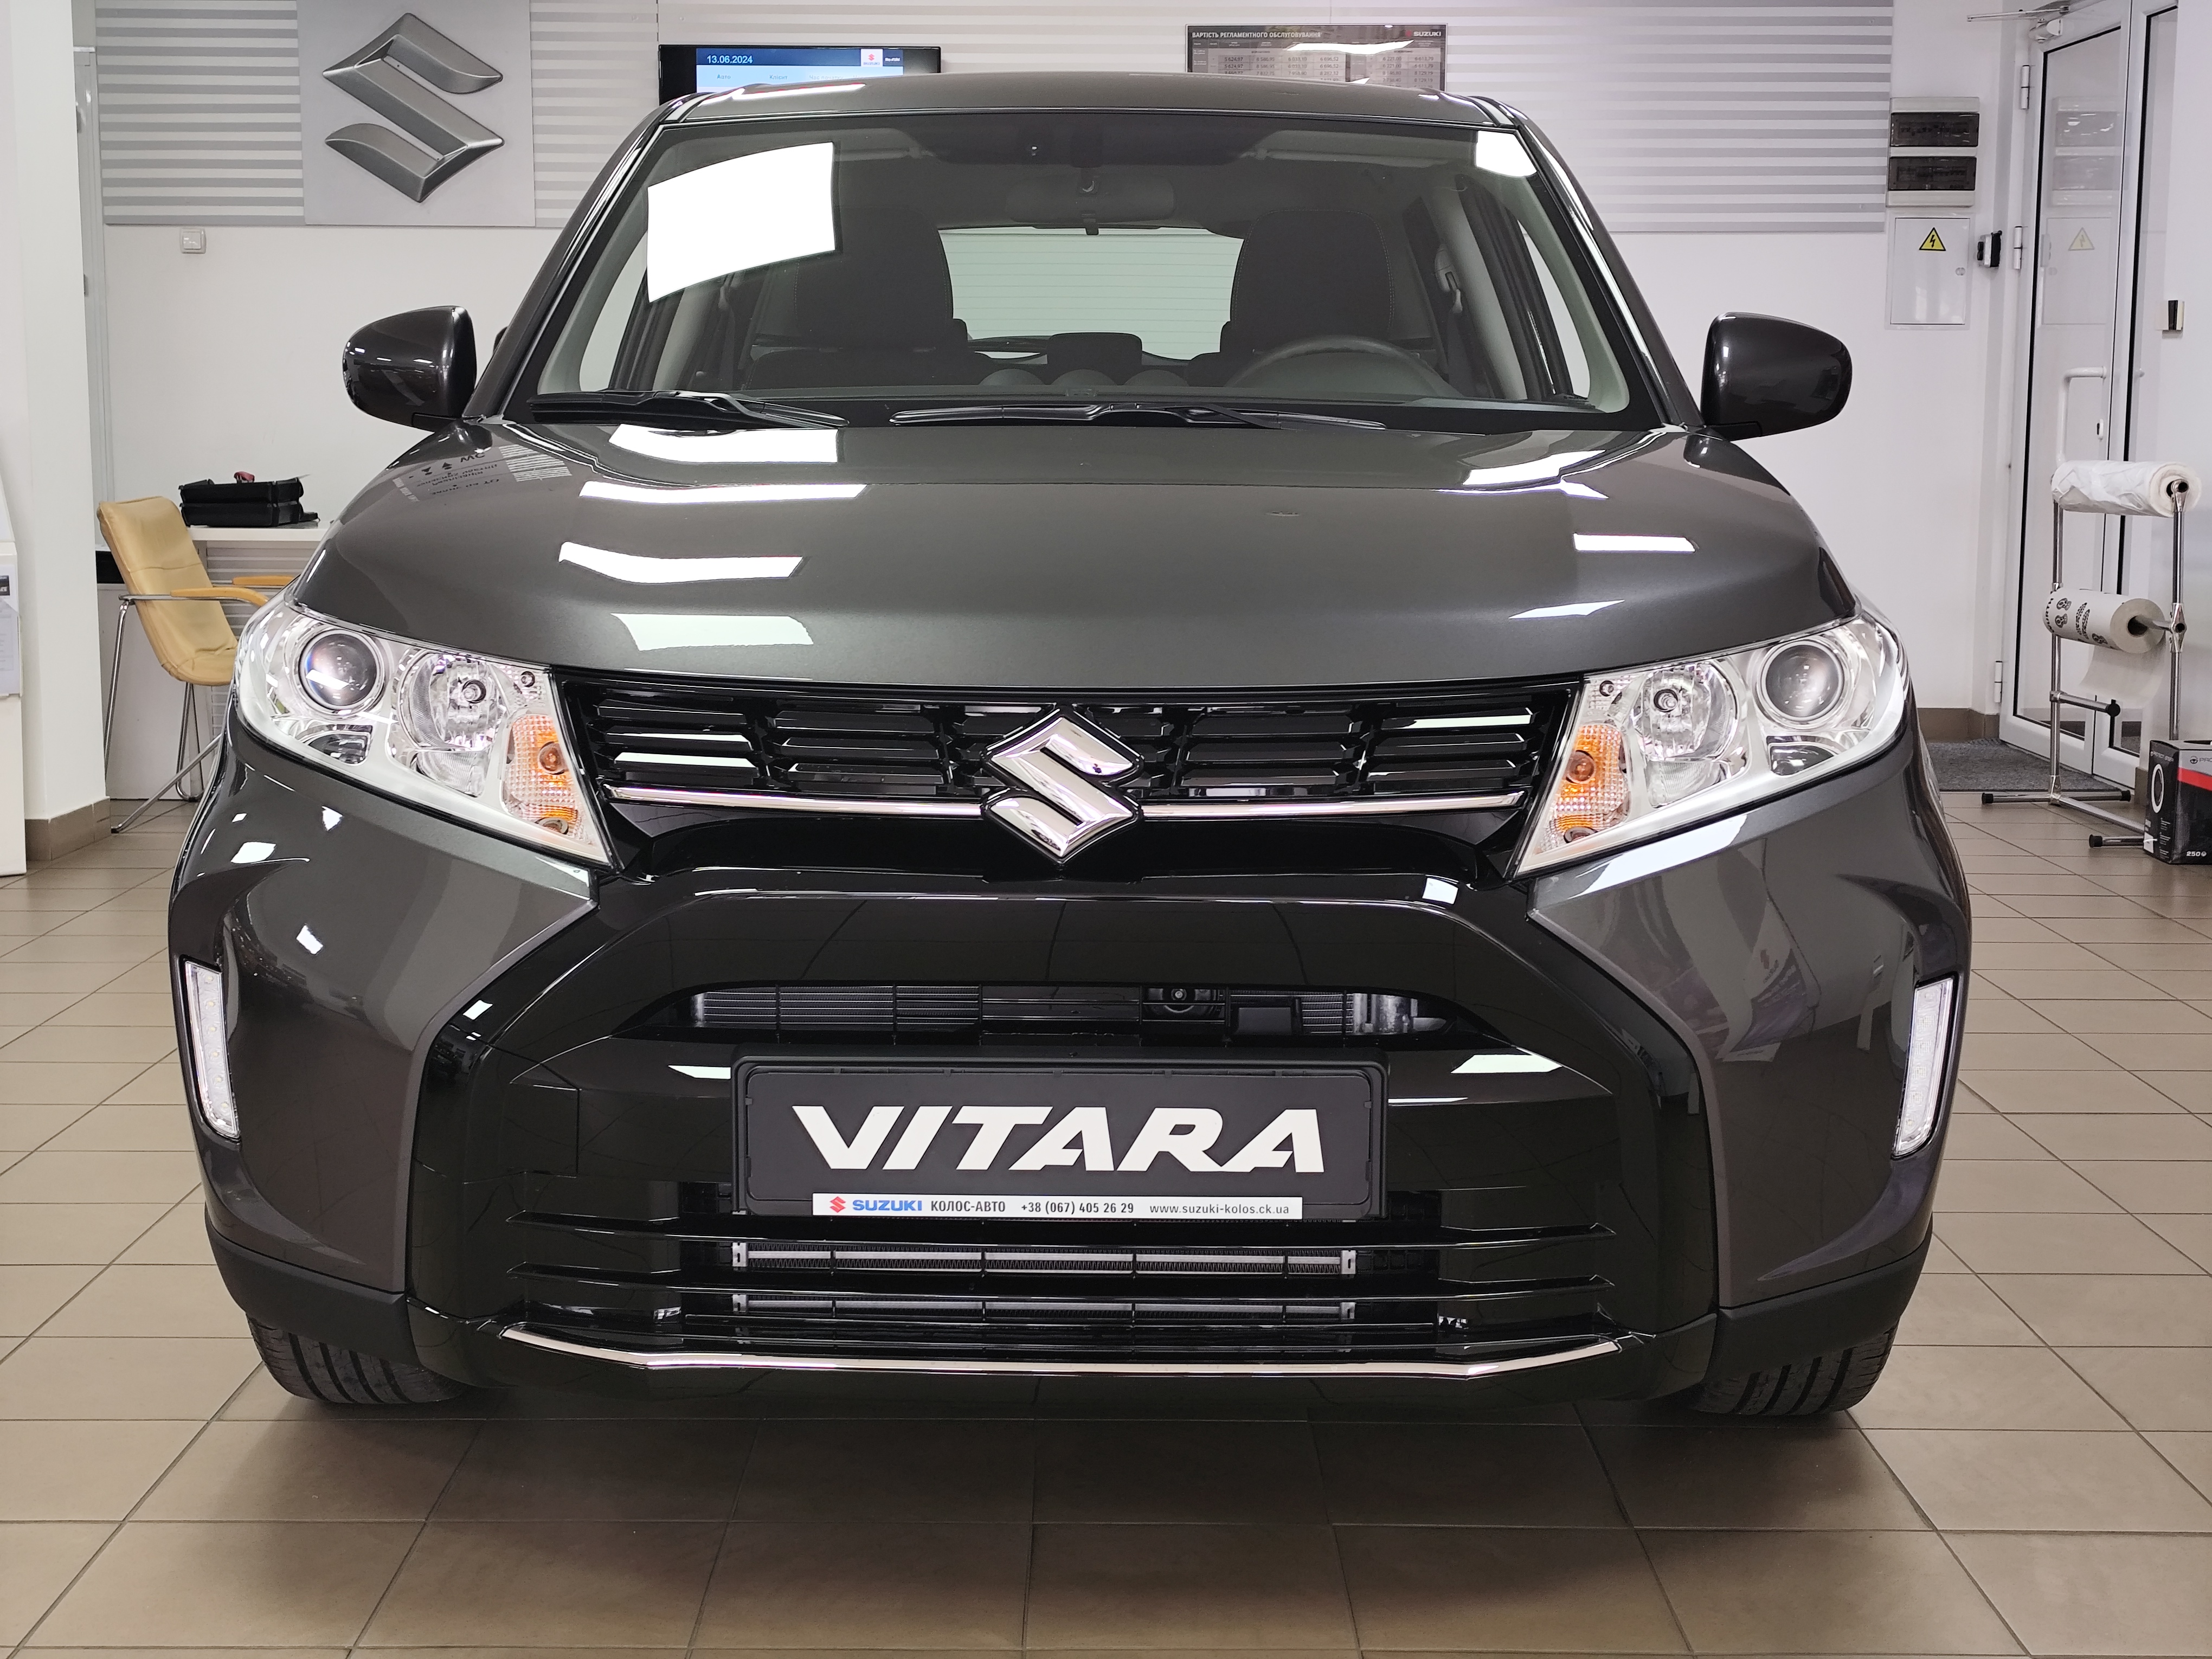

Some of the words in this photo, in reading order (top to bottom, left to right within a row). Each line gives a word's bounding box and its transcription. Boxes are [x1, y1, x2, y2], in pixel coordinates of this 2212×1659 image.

[707, 55, 753, 64] 13.06.2024
[792, 1105, 1324, 1173] VITARA
[852, 1200, 922, 1211] SUZUKI
[931, 1200, 1006, 1212] КОЛОС-АВТО
[1021, 1202, 1041, 1212] +38
[1045, 1201, 1075, 1214] (067)
[1079, 1203, 1099, 1213] 405
[1103, 1203, 1116, 1213] 26
[1121, 1203, 1134, 1213] 29
[1150, 1204, 1289, 1214] www.suzuki-kolos.ck.ua
